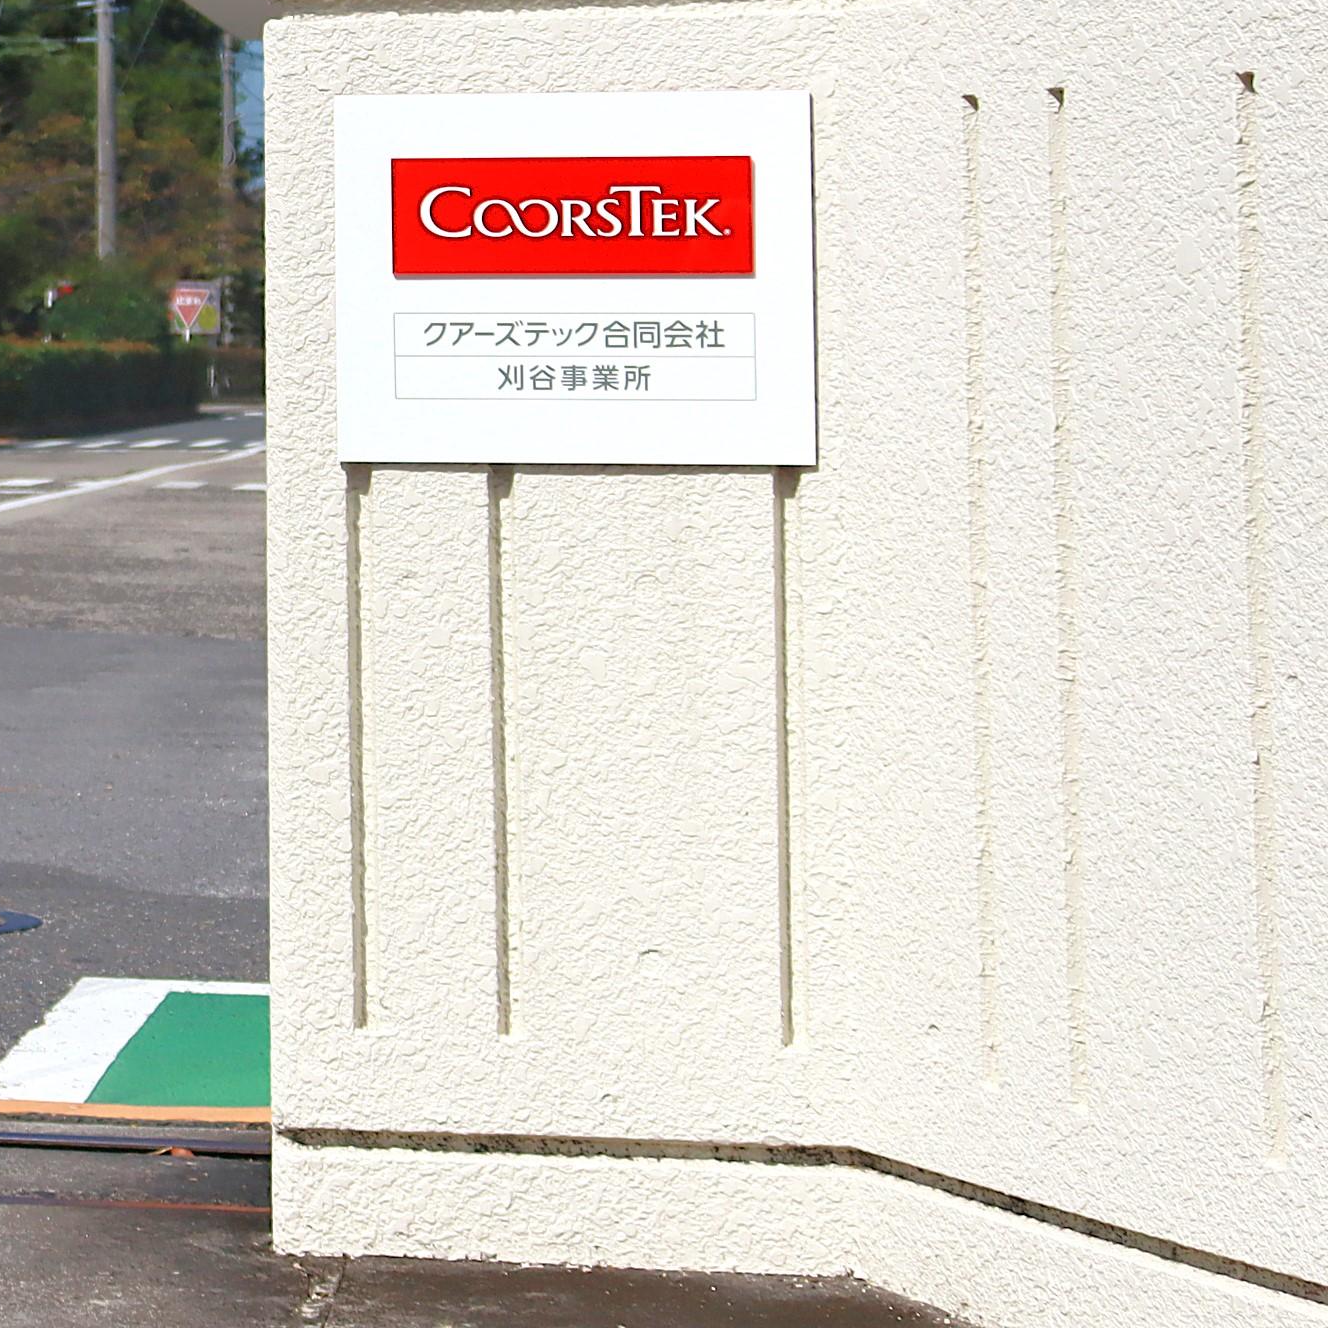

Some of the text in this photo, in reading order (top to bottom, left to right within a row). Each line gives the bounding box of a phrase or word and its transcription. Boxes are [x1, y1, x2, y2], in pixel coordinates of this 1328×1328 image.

[424, 320, 726, 349] クアーズテック合同会社
[497, 364, 651, 392] 刈谷事業所
